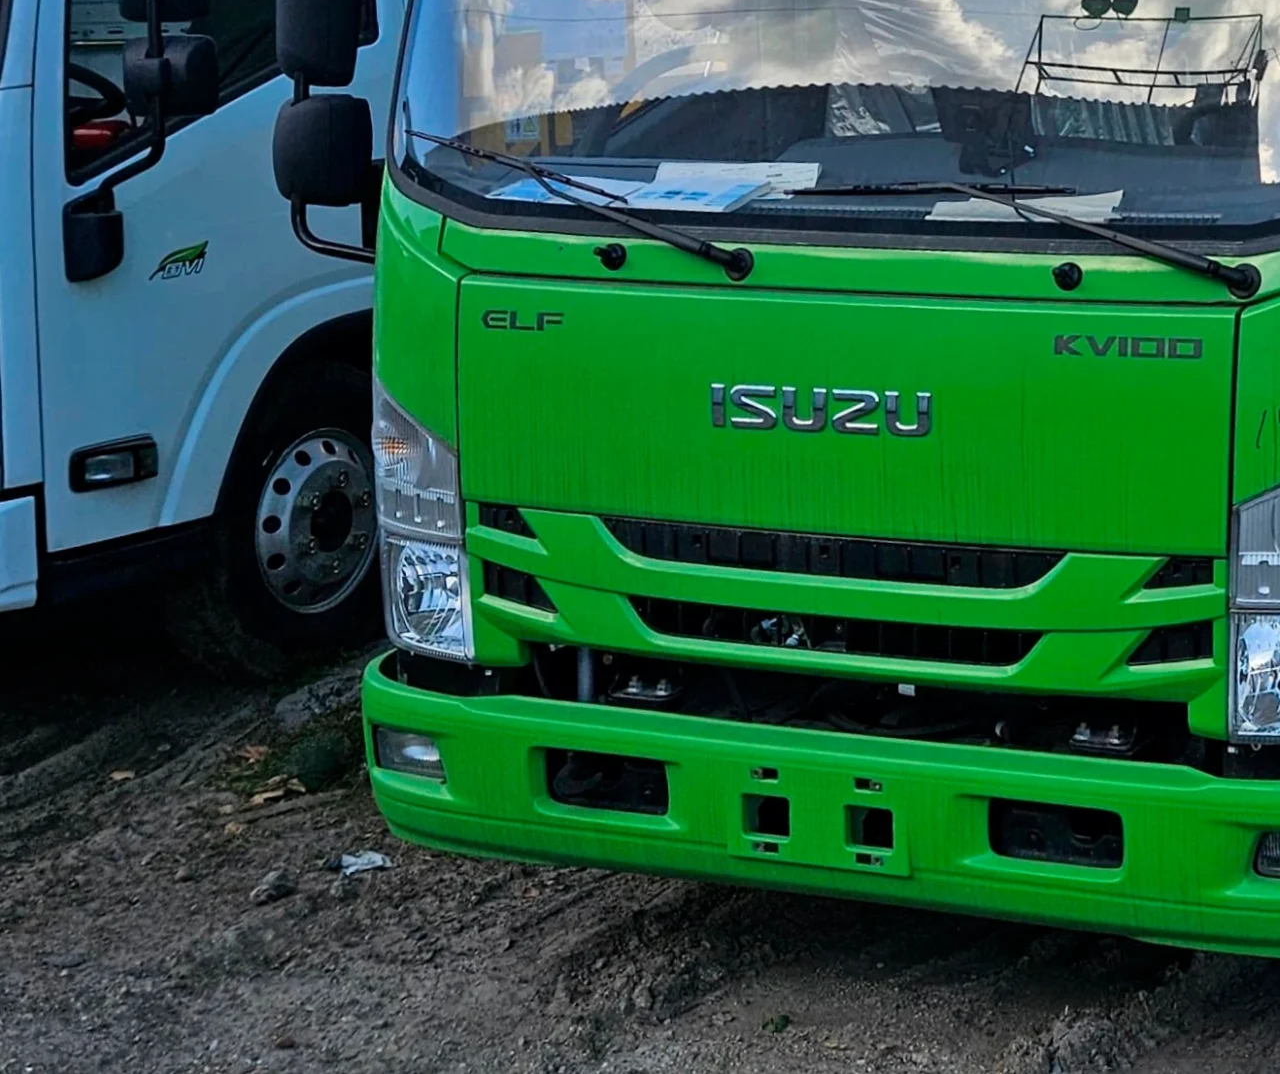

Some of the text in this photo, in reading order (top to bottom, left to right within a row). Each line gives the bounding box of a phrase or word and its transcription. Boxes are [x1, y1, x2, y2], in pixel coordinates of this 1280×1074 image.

[481, 309, 565, 332] ELF
[1052, 333, 1205, 360] KV100
[710, 382, 934, 437] ISUZU
